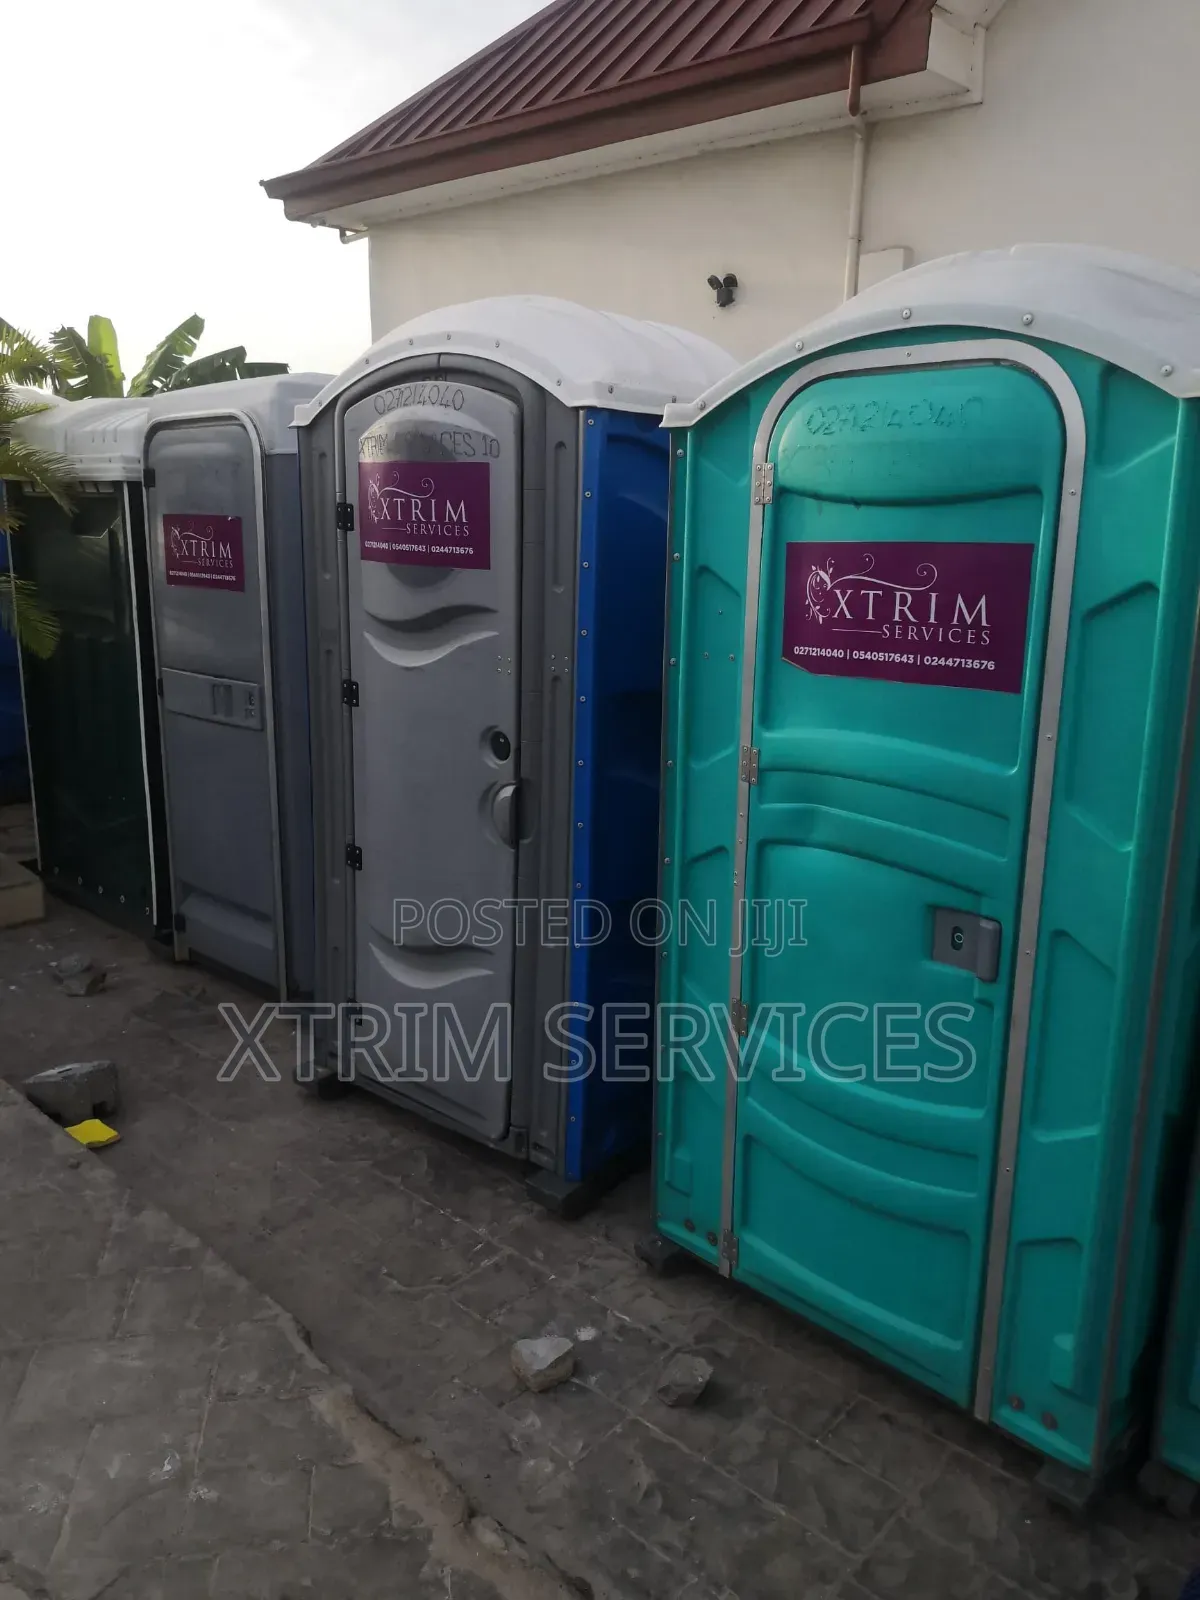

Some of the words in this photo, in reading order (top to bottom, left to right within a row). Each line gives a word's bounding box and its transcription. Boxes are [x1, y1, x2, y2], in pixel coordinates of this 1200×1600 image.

[380, 498, 469, 523] XTRIM
[406, 523, 470, 537] SERVICES
[181, 539, 232, 559] XTRIM
[431, 545, 474, 555] 0244713676
[197, 558, 234, 568] SERVICES
[832, 589, 991, 627] XTRIM
[881, 624, 991, 646] SERVICES
[793, 646, 845, 659] 0271214040
[852, 650, 915, 664] 0540517643
[923, 655, 996, 671] 0244713676
